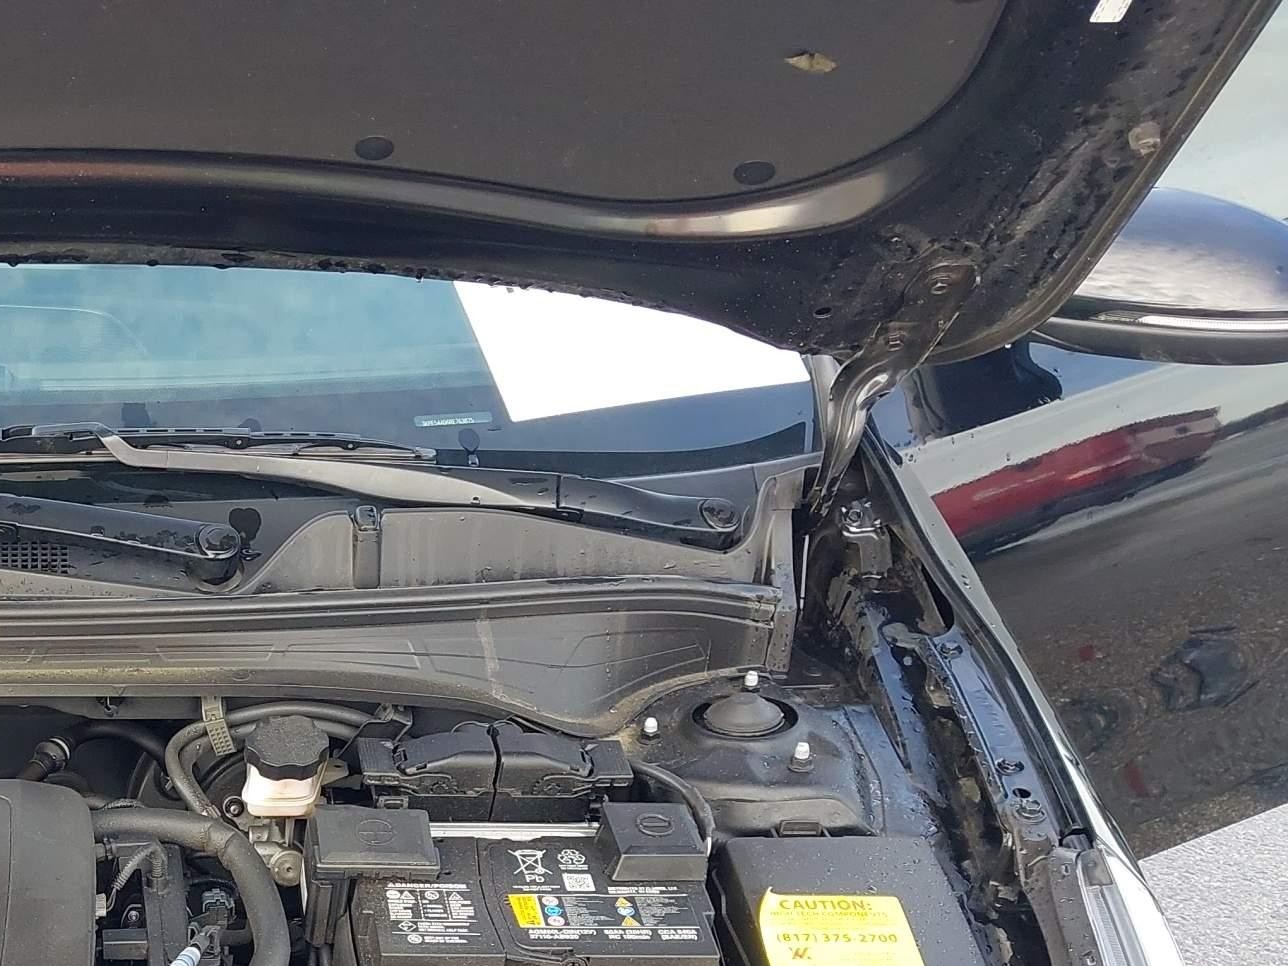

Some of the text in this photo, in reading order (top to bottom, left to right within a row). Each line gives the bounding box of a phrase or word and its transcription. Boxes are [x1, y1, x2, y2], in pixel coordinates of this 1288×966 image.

[525, 874, 545, 883] Pb
[778, 899, 873, 911] CAUTION:
[776, 933, 818, 943] (817)
